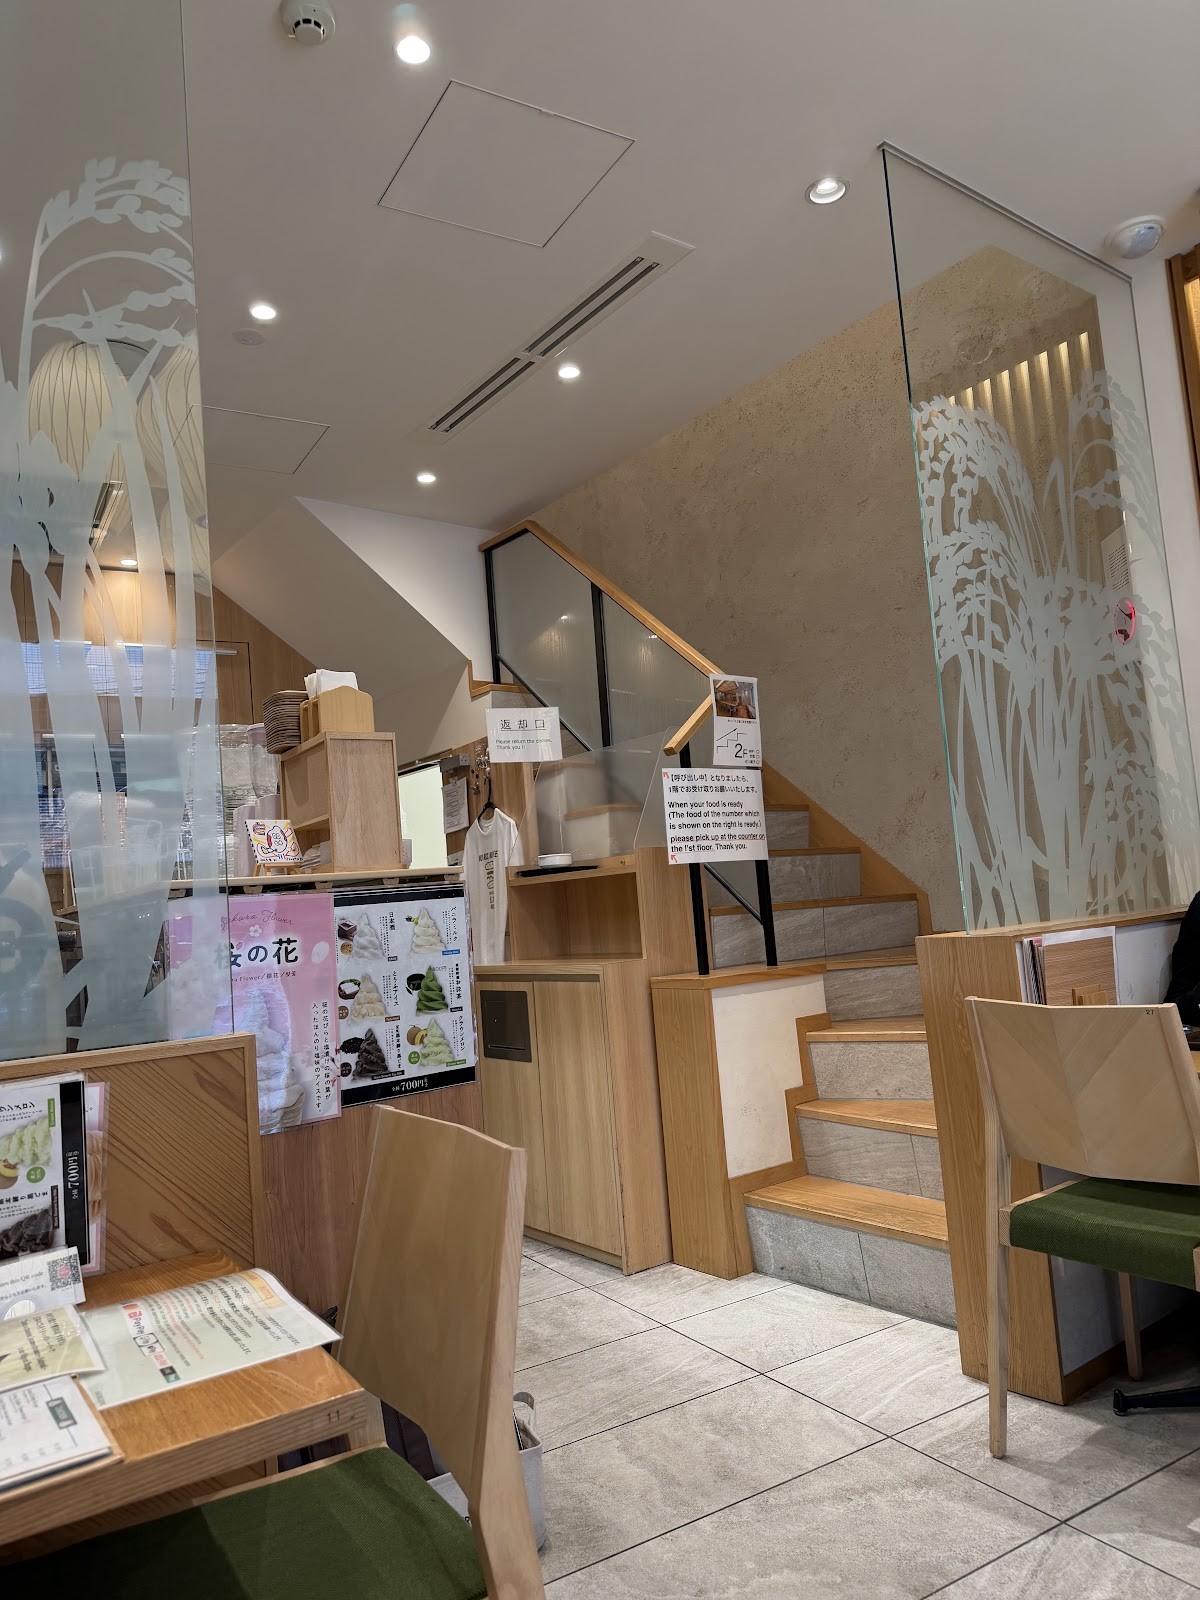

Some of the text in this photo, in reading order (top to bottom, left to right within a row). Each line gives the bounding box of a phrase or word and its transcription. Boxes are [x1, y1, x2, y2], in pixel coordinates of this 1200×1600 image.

[668, 801, 688, 809] When
[689, 801, 705, 810] your
[668, 811, 684, 820] (The
[744, 809, 760, 817] which
[669, 822, 676, 830] is
[723, 821, 737, 829] right
[670, 835, 694, 844] please
[695, 834, 710, 842] pick
[711, 834, 719, 842] up
[671, 844, 683, 852] the
[696, 844, 714, 852] floor.
[715, 842, 734, 850] Thank
[734, 842, 748, 851] you.
